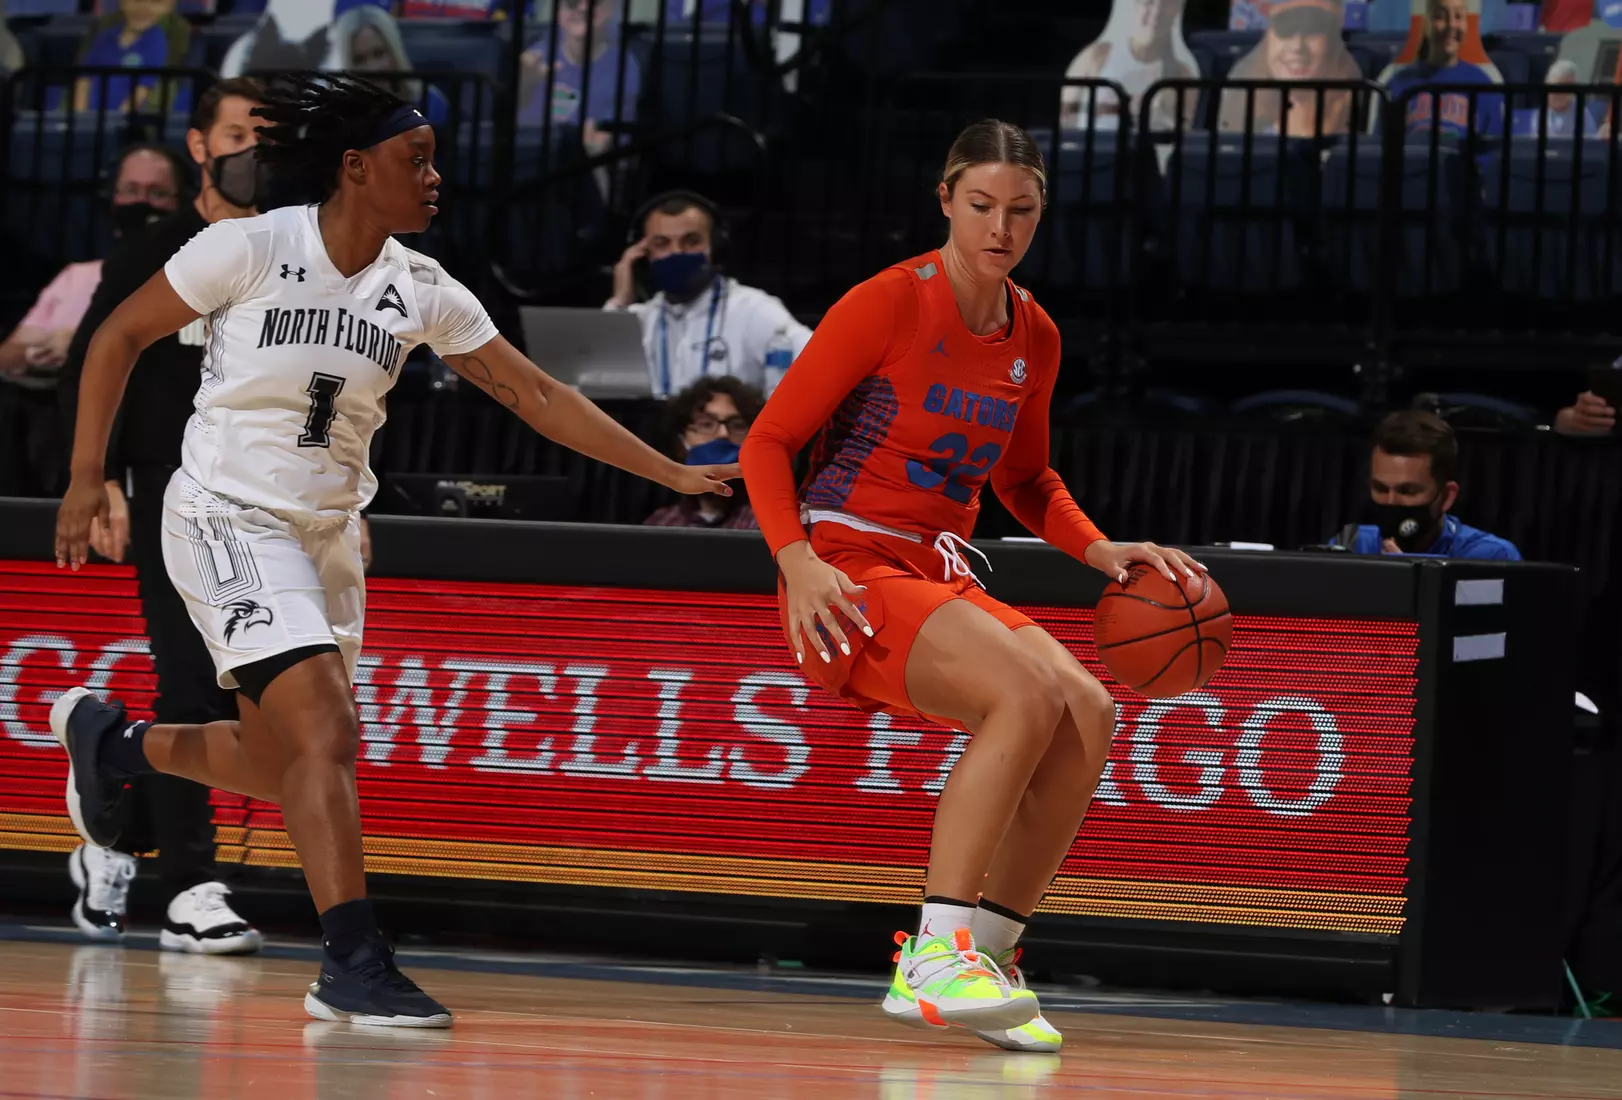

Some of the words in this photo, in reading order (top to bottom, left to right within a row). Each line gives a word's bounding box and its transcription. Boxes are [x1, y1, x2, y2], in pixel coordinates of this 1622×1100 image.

[256, 307, 330, 349] NORTH
[297, 371, 347, 449] 1
[922, 383, 1018, 433] GATORS
[353, 655, 812, 790] WELLS
[853, 692, 1346, 817] FGO
